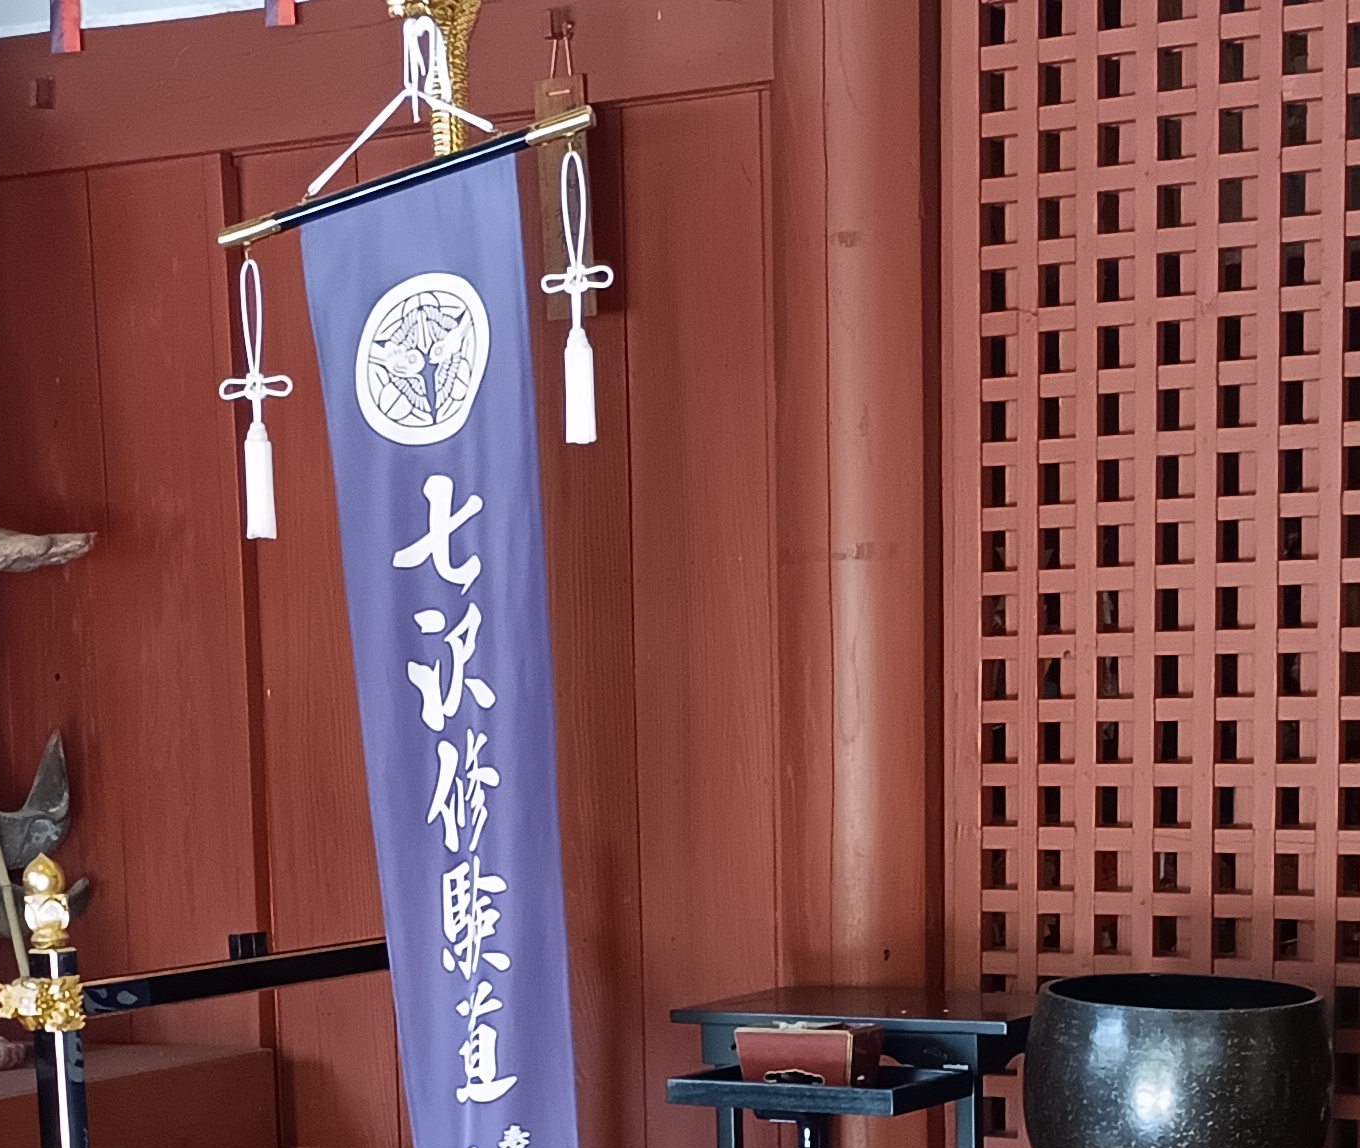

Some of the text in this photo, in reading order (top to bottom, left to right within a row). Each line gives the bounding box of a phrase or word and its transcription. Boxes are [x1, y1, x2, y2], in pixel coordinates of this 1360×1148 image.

[393, 475, 517, 1104] 七沢修験道
